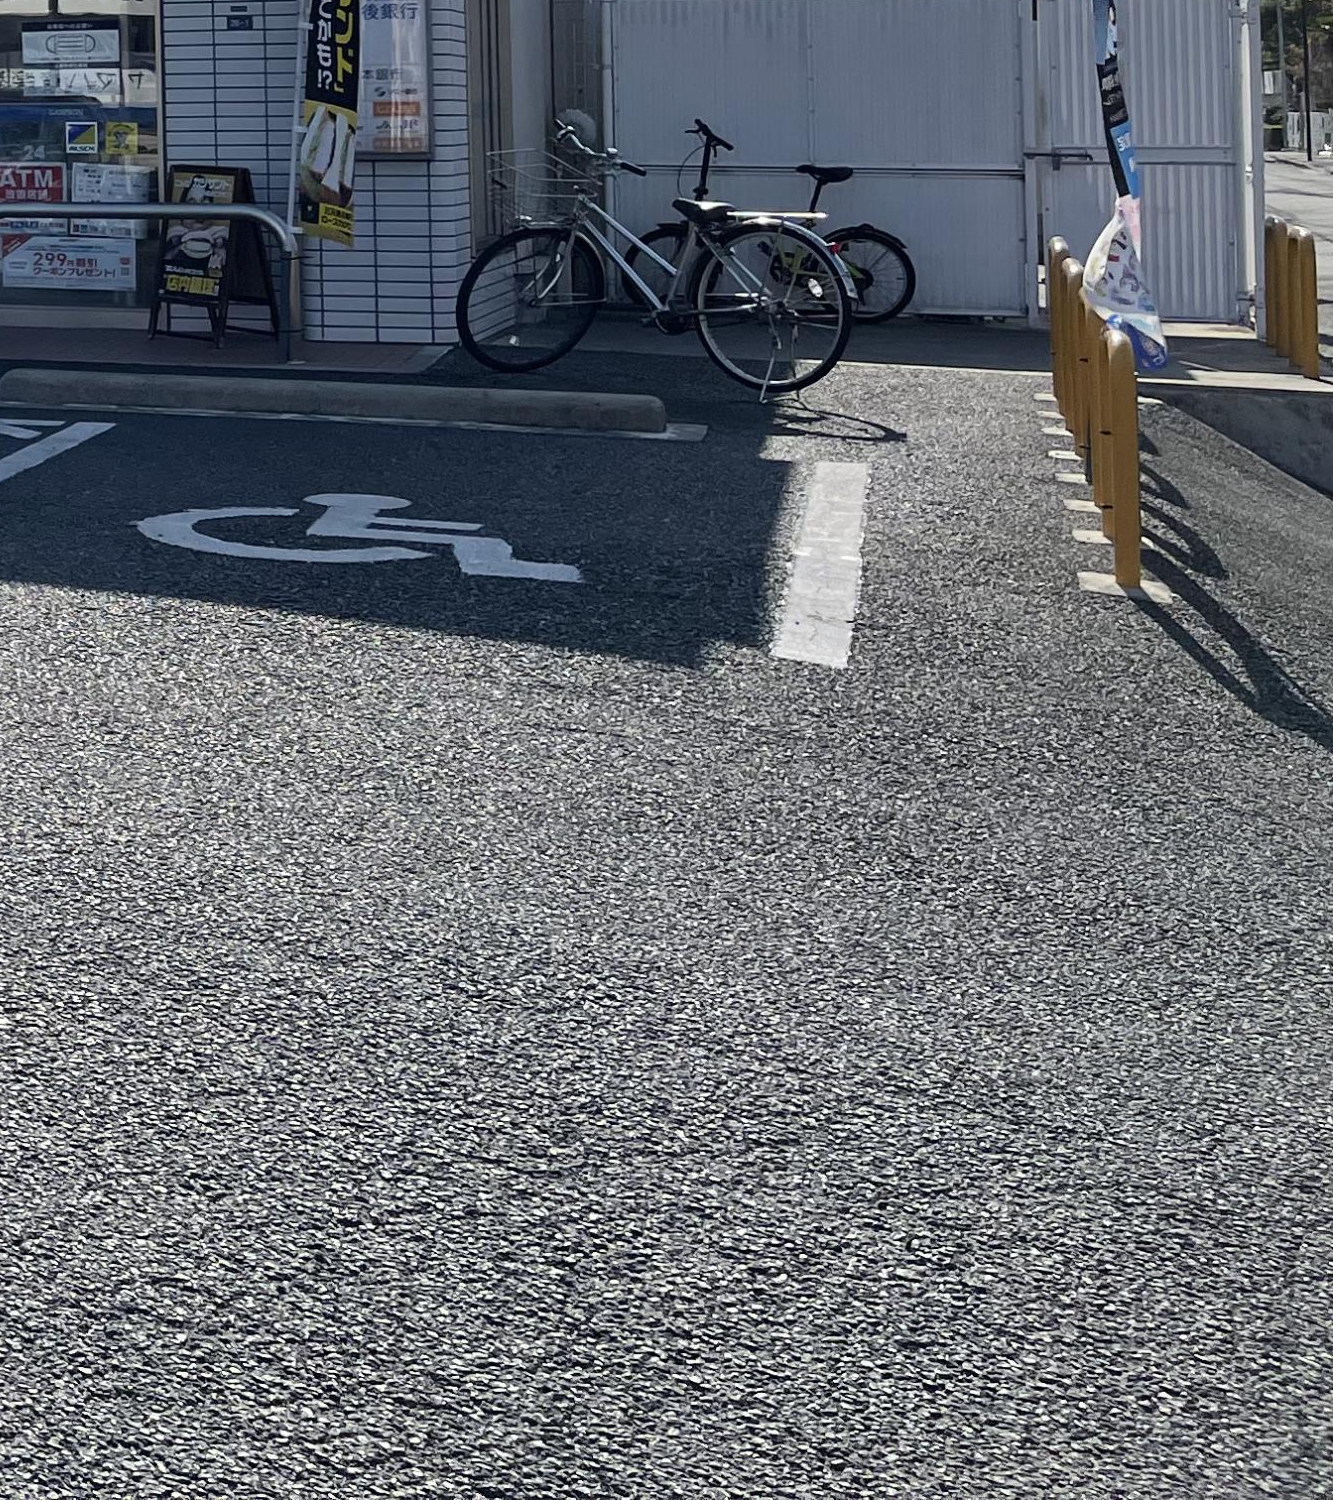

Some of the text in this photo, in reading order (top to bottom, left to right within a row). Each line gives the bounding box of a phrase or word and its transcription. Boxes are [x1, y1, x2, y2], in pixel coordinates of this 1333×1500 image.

[361, 3, 419, 21] 後銀行
[362, 69, 404, 81] 本銀行
